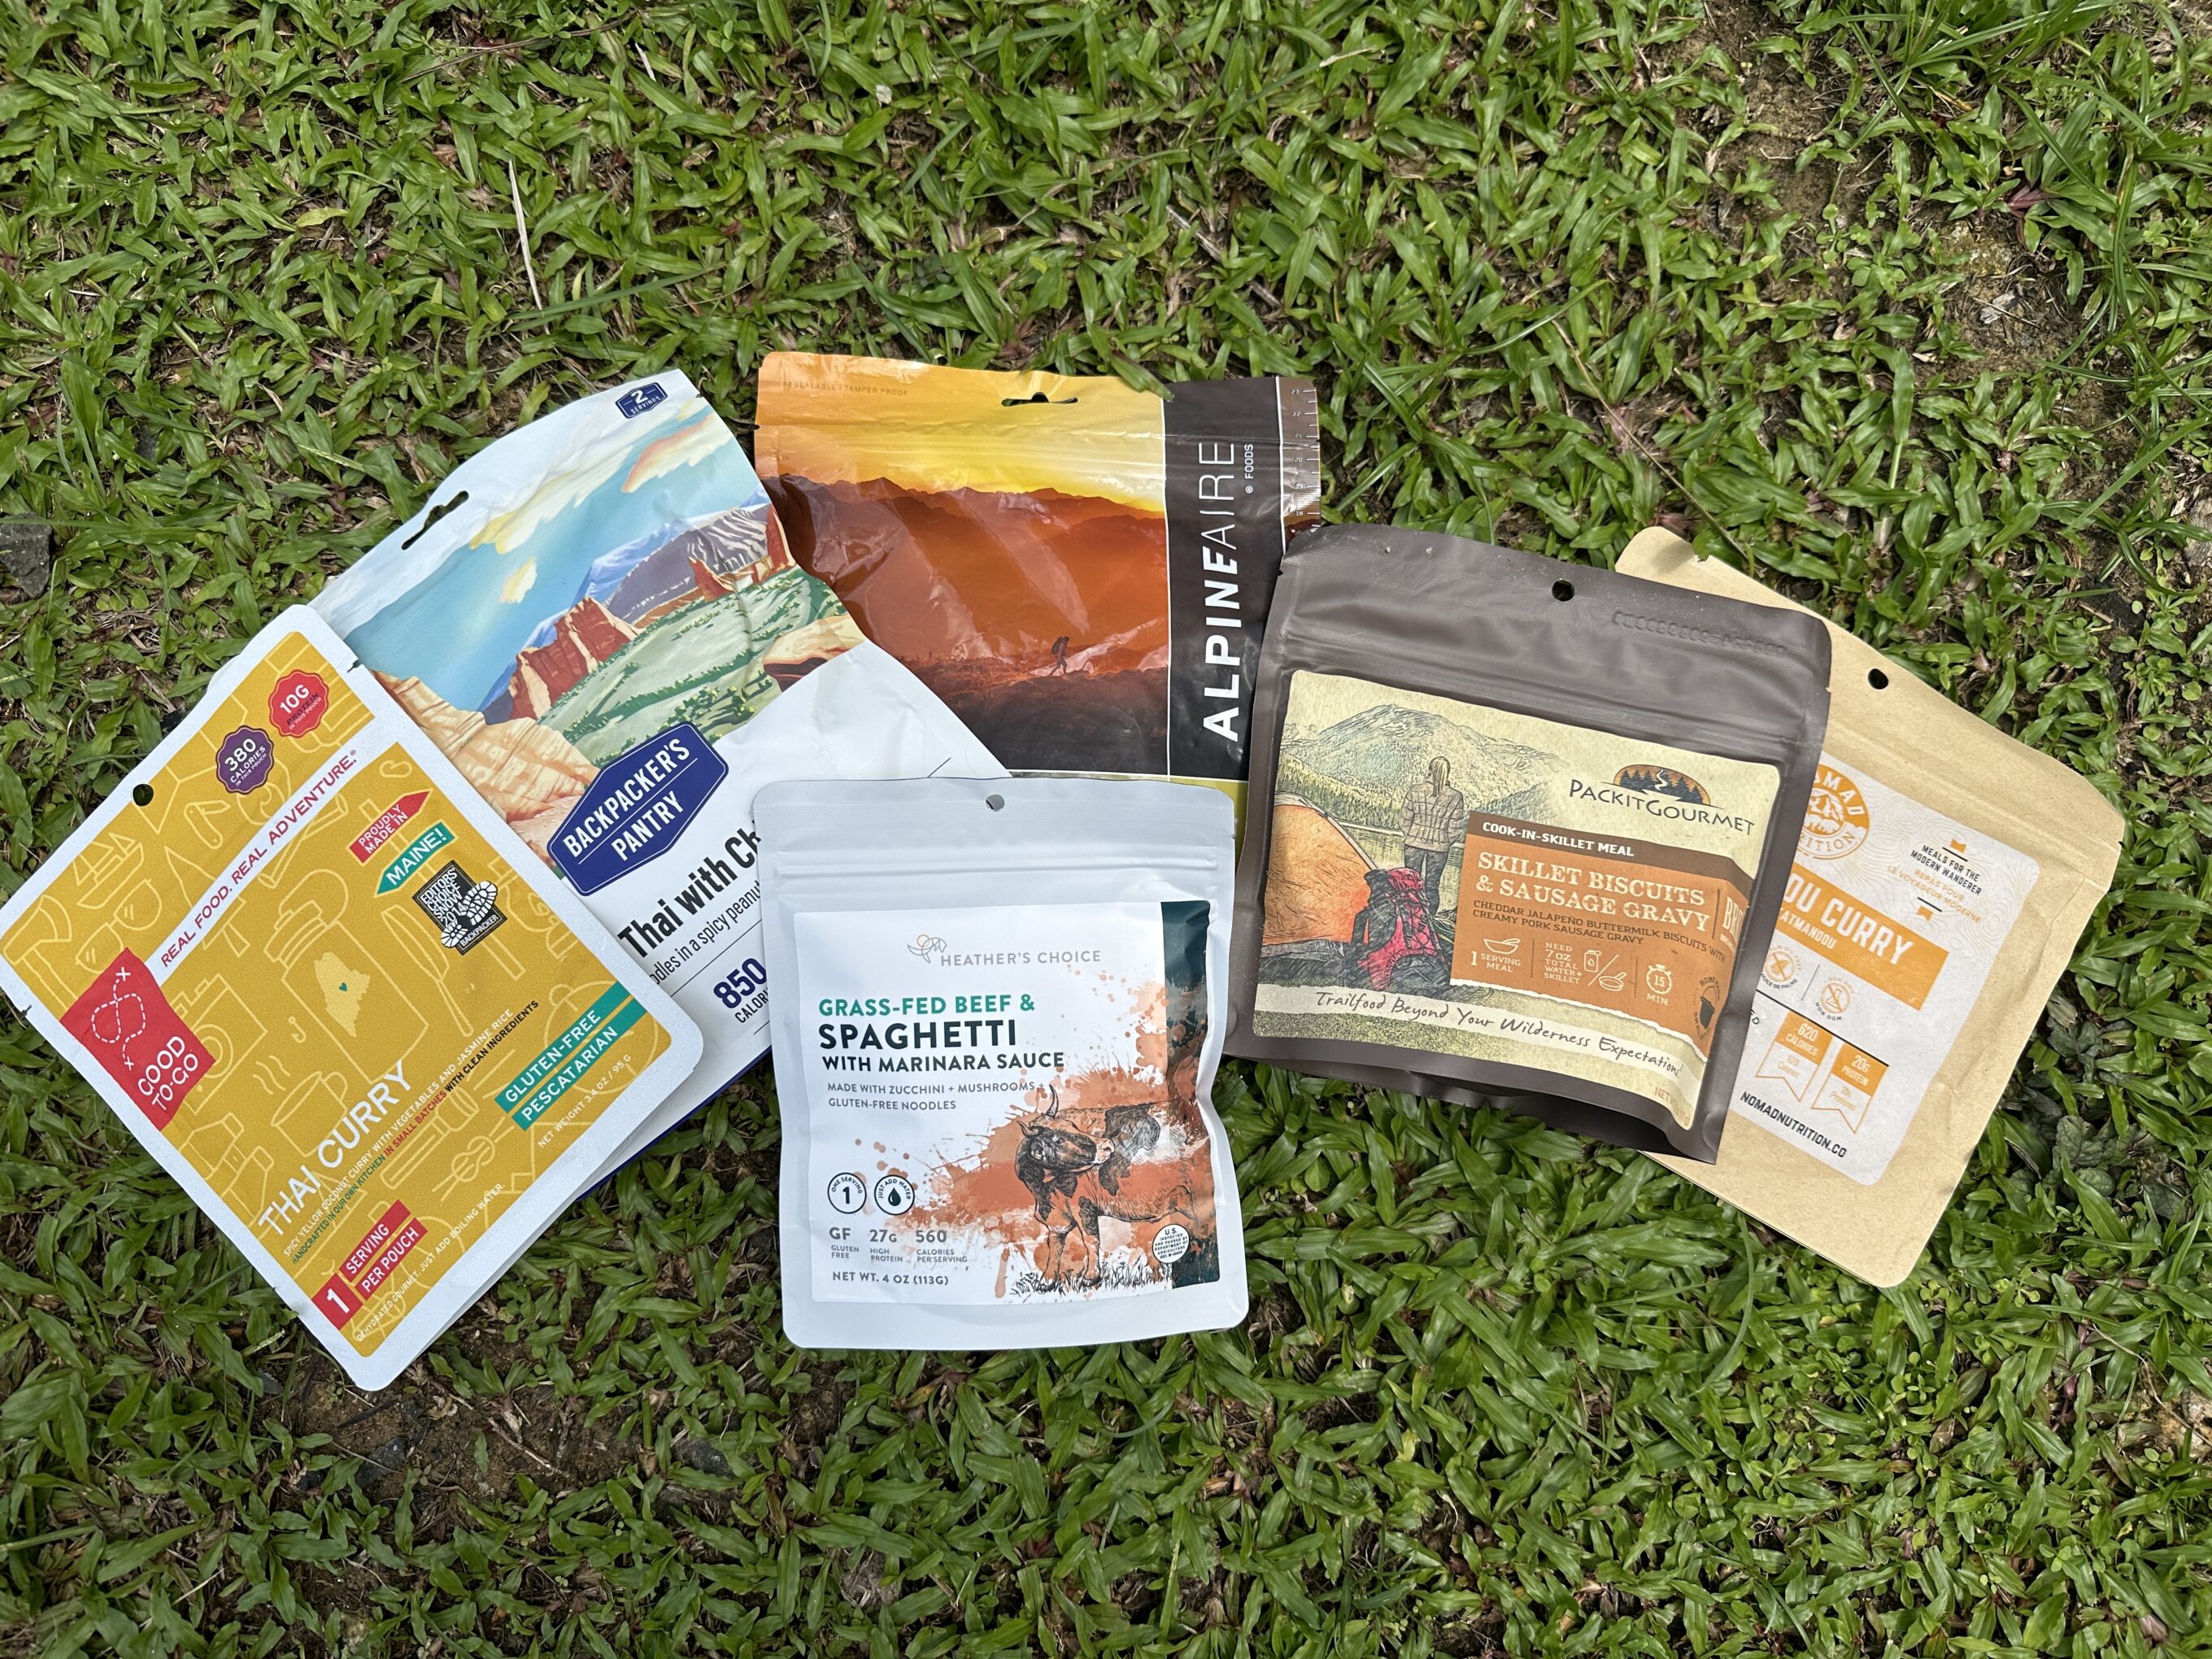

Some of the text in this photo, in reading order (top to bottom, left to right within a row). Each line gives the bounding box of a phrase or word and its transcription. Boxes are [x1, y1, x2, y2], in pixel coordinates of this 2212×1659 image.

[631, 390, 648, 404] 2
[845, 385, 877, 394] TAMPER
[880, 388, 908, 396] PROOF
[1244, 444, 1253, 479] FOODS
[1199, 442, 1242, 742] ALPINEAIRE
[280, 685, 309, 714] 10G
[287, 692, 319, 725] PROTEIN
[224, 738, 256, 772] 380
[230, 746, 266, 782] CALORIES
[563, 738, 690, 857] BACKPACKER'S
[1569, 779, 1755, 835] PACKITGOURMET
[359, 804, 401, 846] PROUDLY
[364, 812, 408, 853] MADE IN
[611, 790, 683, 860] PANTRY
[1483, 821, 1635, 857] COOK-IN-SKILLET MEAL
[385, 828, 447, 886] MAINE!
[1910, 851, 1982, 895] MODERN WANDERER
[1922, 845, 1980, 882] MEALS FOR THE
[427, 880, 460, 911] CHOICE
[617, 820, 761, 957] Thai with Ch
[1478, 852, 1705, 906] SKILLET BISCUITS
[1914, 869, 1965, 901] REPAS POUR
[160, 931, 196, 968] REAL
[194, 886, 233, 928] FOOD.
[232, 846, 267, 884] REAL
[433, 890, 462, 919] SNOW
[1476, 874, 1493, 893] &
[1499, 879, 1617, 915] SAUSAGE
[1623, 902, 1709, 932] GRAVY
[1899, 871, 1981, 923] VOYAGEUR MODERNE
[459, 914, 499, 947] BACKPACKER
[675, 914, 730, 961] in a spicy
[1473, 910, 1644, 944] CREAMY PORK SAUSAGE GRAVY
[1474, 900, 1524, 917] CHEDDAR
[1527, 909, 1583, 926] JALAPEÑO
[1587, 920, 1660, 938] BUTTERMILK
[1663, 932, 1707, 951] BISCUITS
[1709, 946, 1726, 964] WITH
[1821, 896, 1913, 964] CURRY
[941, 950, 1100, 966] HEATHER'S CHOICE
[1471, 951, 1478, 966] 1
[1481, 954, 1521, 966] SERVING
[1545, 943, 1572, 952] NEED
[1545, 958, 1578, 969] TOTAL
[1546, 949, 1571, 961] 7 OZ
[714, 958, 767, 1008] 850
[1487, 962, 1513, 973] MEAL
[1544, 973, 1580, 984] SKILLET
[1654, 975, 1665, 986] 15
[1781, 978, 1797, 989] PALME
[818, 994, 1035, 1016] GRASS-FED BEEF &
[1647, 993, 1668, 1005] MIN
[818, 1019, 1016, 1050] SPAGHETTI
[1317, 991, 1684, 1078] Trailfood Beyond Your Wilderness Expectations!
[1785, 1034, 1818, 1056] CALORIES
[1798, 1023, 1818, 1042] 620
[138, 1036, 185, 1095] GOOD
[505, 1009, 601, 1103] GLUTEN-FREE
[822, 1052, 1065, 1072] WITH MARINARA SAUCE
[152, 1054, 198, 1110] TO-GO
[520, 1026, 617, 1121] PESCATARIAN
[828, 1082, 1035, 1095] MADE WITH ZUCCHINI MUSHROOMS
[1841, 1066, 1869, 1086] PROTEIN
[829, 1098, 956, 1110] GLUTEN-FREE NOODLES
[1655, 1086, 1670, 1101] NET
[538, 1077, 609, 1148] NET WEIGHT OZ
[1740, 1091, 1848, 1158] NOMADNUTRITION.CO
[258, 1059, 411, 1235] THAI CURRY
[284, 1008, 513, 1257] SPICY YELLOW COCONUT CURRY WITH VEGETABLES AND JASMINE RICE
[292, 1000, 538, 1264] HANDCRAFTED KITCHEN SMALL BATCHES WITH CLEAN INGREDIENTS
[841, 1176, 863, 1194] SERVING
[843, 1187, 850, 1204] 1
[899, 1181, 912, 1200] WATER
[346, 1224, 390, 1274] SERVING
[830, 1227, 947, 1243] GF 27G 560
[357, 1183, 505, 1342] DEHYDRATED GOURMET. JUST ADD BOILING WATER.
[361, 1227, 419, 1292] PER POUCH
[833, 1272, 949, 1285] NET WT. 4 OZ (113G)
[327, 1288, 350, 1314] 1
